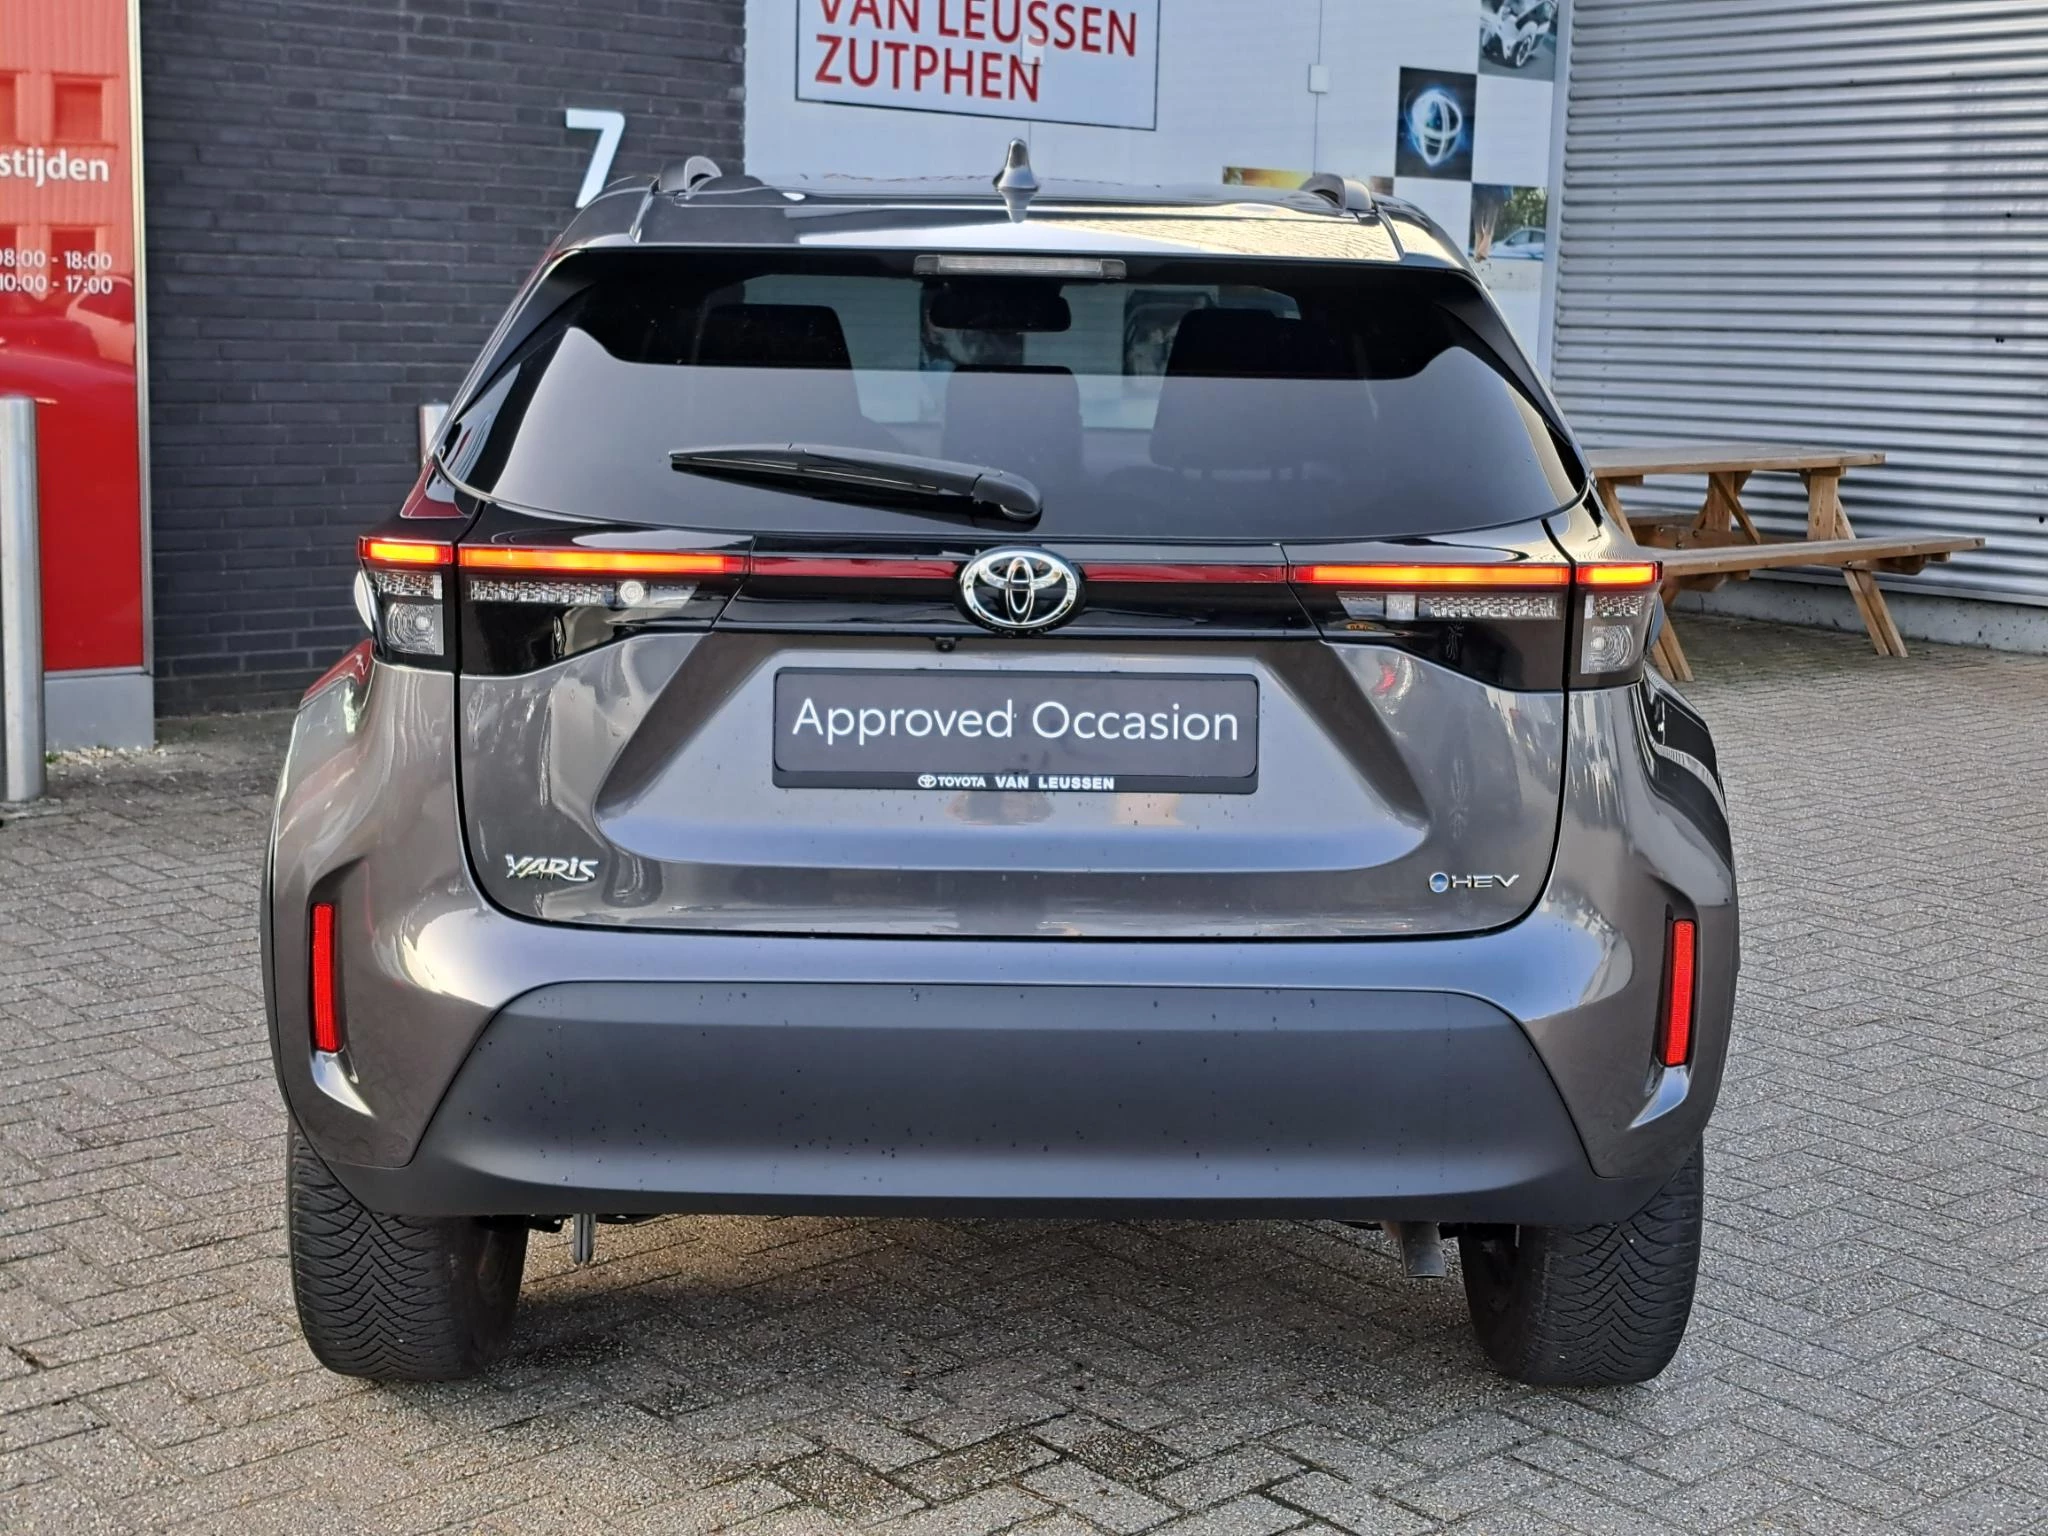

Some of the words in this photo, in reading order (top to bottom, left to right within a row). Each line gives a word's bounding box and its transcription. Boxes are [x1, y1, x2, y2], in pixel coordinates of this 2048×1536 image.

[938, 0, 1137, 57] LEUSSEN
[815, 34, 1040, 102] ZUTPHEN
[0, 147, 109, 187] stijden
[565, 107, 626, 209] 7
[0, 248, 46, 268] 8:00
[64, 250, 112, 270] 18:00
[65, 275, 113, 295] 17:00
[792, 697, 1013, 746] Approved
[1032, 701, 1238, 741] Occasion
[937, 775, 986, 788] TOYOTA
[995, 776, 1029, 789] VAN
[1038, 777, 1115, 790] LEUSSEN
[1451, 873, 1520, 889] HEV
